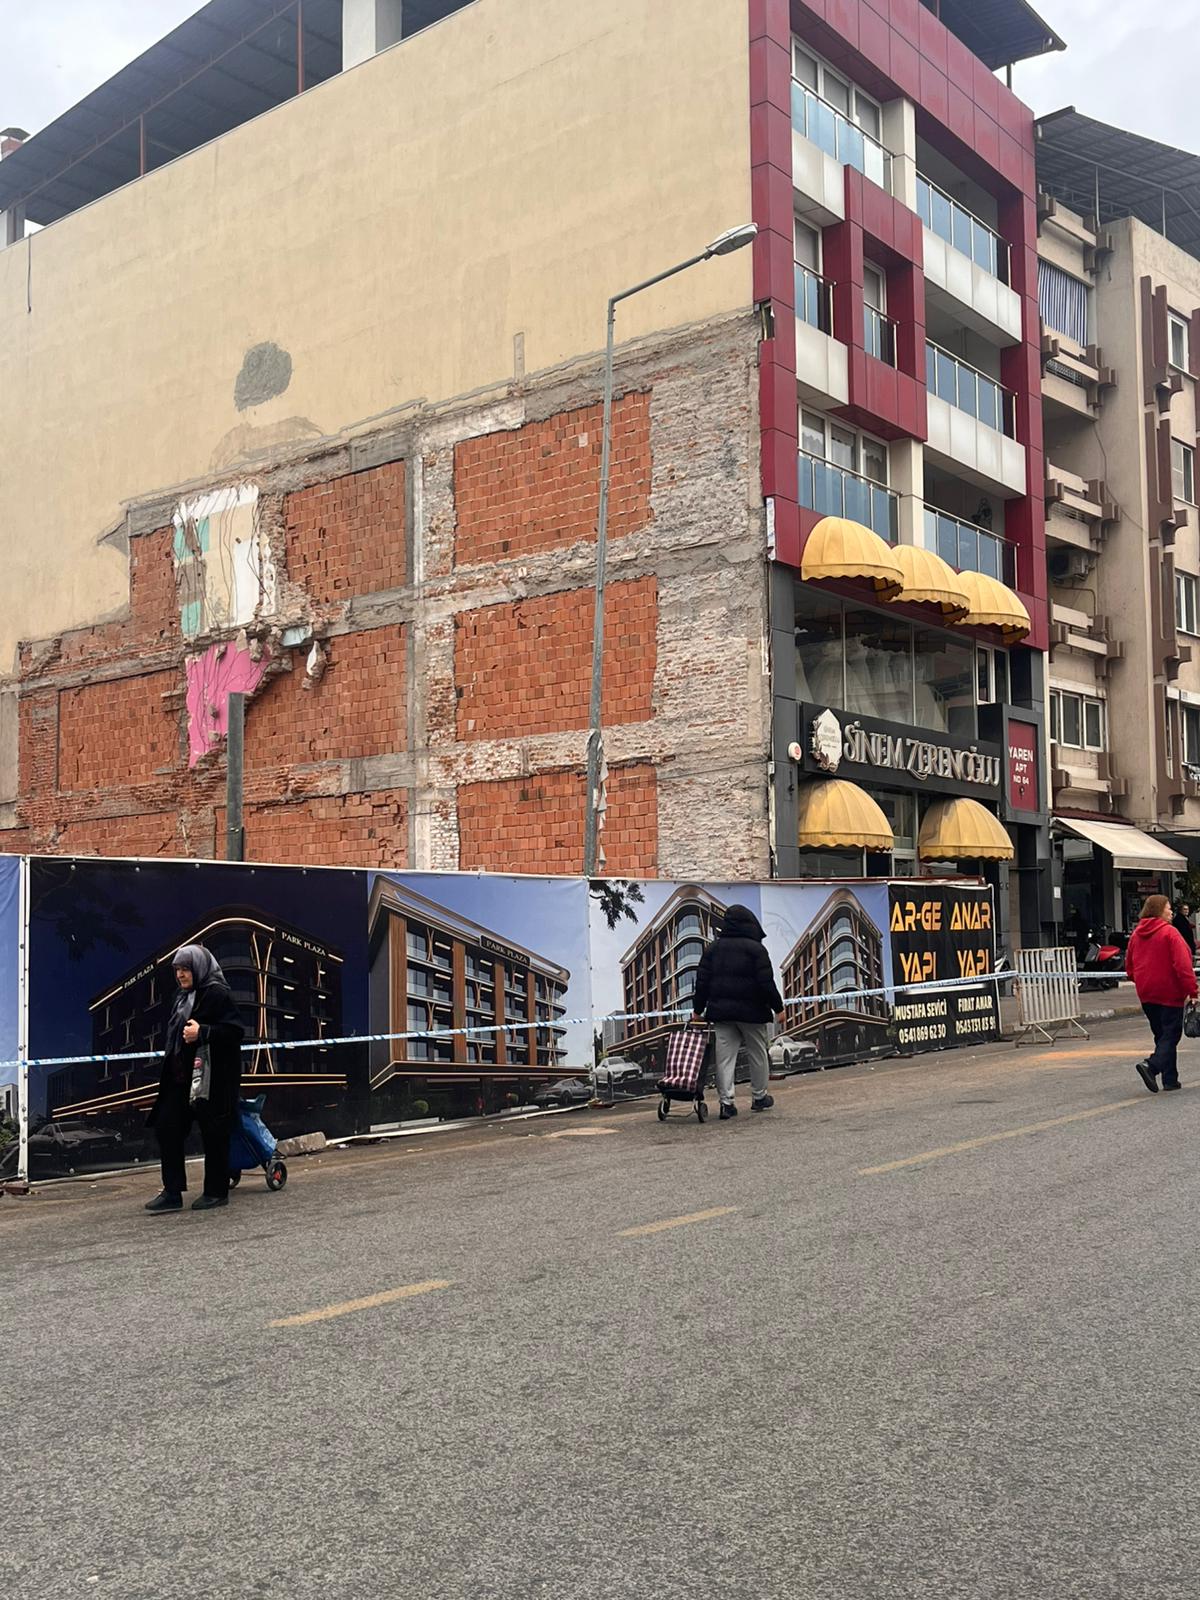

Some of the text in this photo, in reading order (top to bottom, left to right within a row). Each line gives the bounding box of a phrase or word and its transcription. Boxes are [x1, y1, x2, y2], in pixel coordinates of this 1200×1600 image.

[844, 720, 906, 770] SİNEM
[1008, 745, 1033, 762] YAREN
[1015, 762, 1027, 773] APT
[890, 901, 942, 932] AR-GE
[950, 901, 991, 930] ANAR
[281, 931, 326, 956] PARK PLAZA
[486, 940, 528, 964] PARK PLAZA
[899, 951, 936, 983] YAPI
[957, 948, 989, 979] YAPI
[895, 1003, 927, 1021] MUSTAFA
